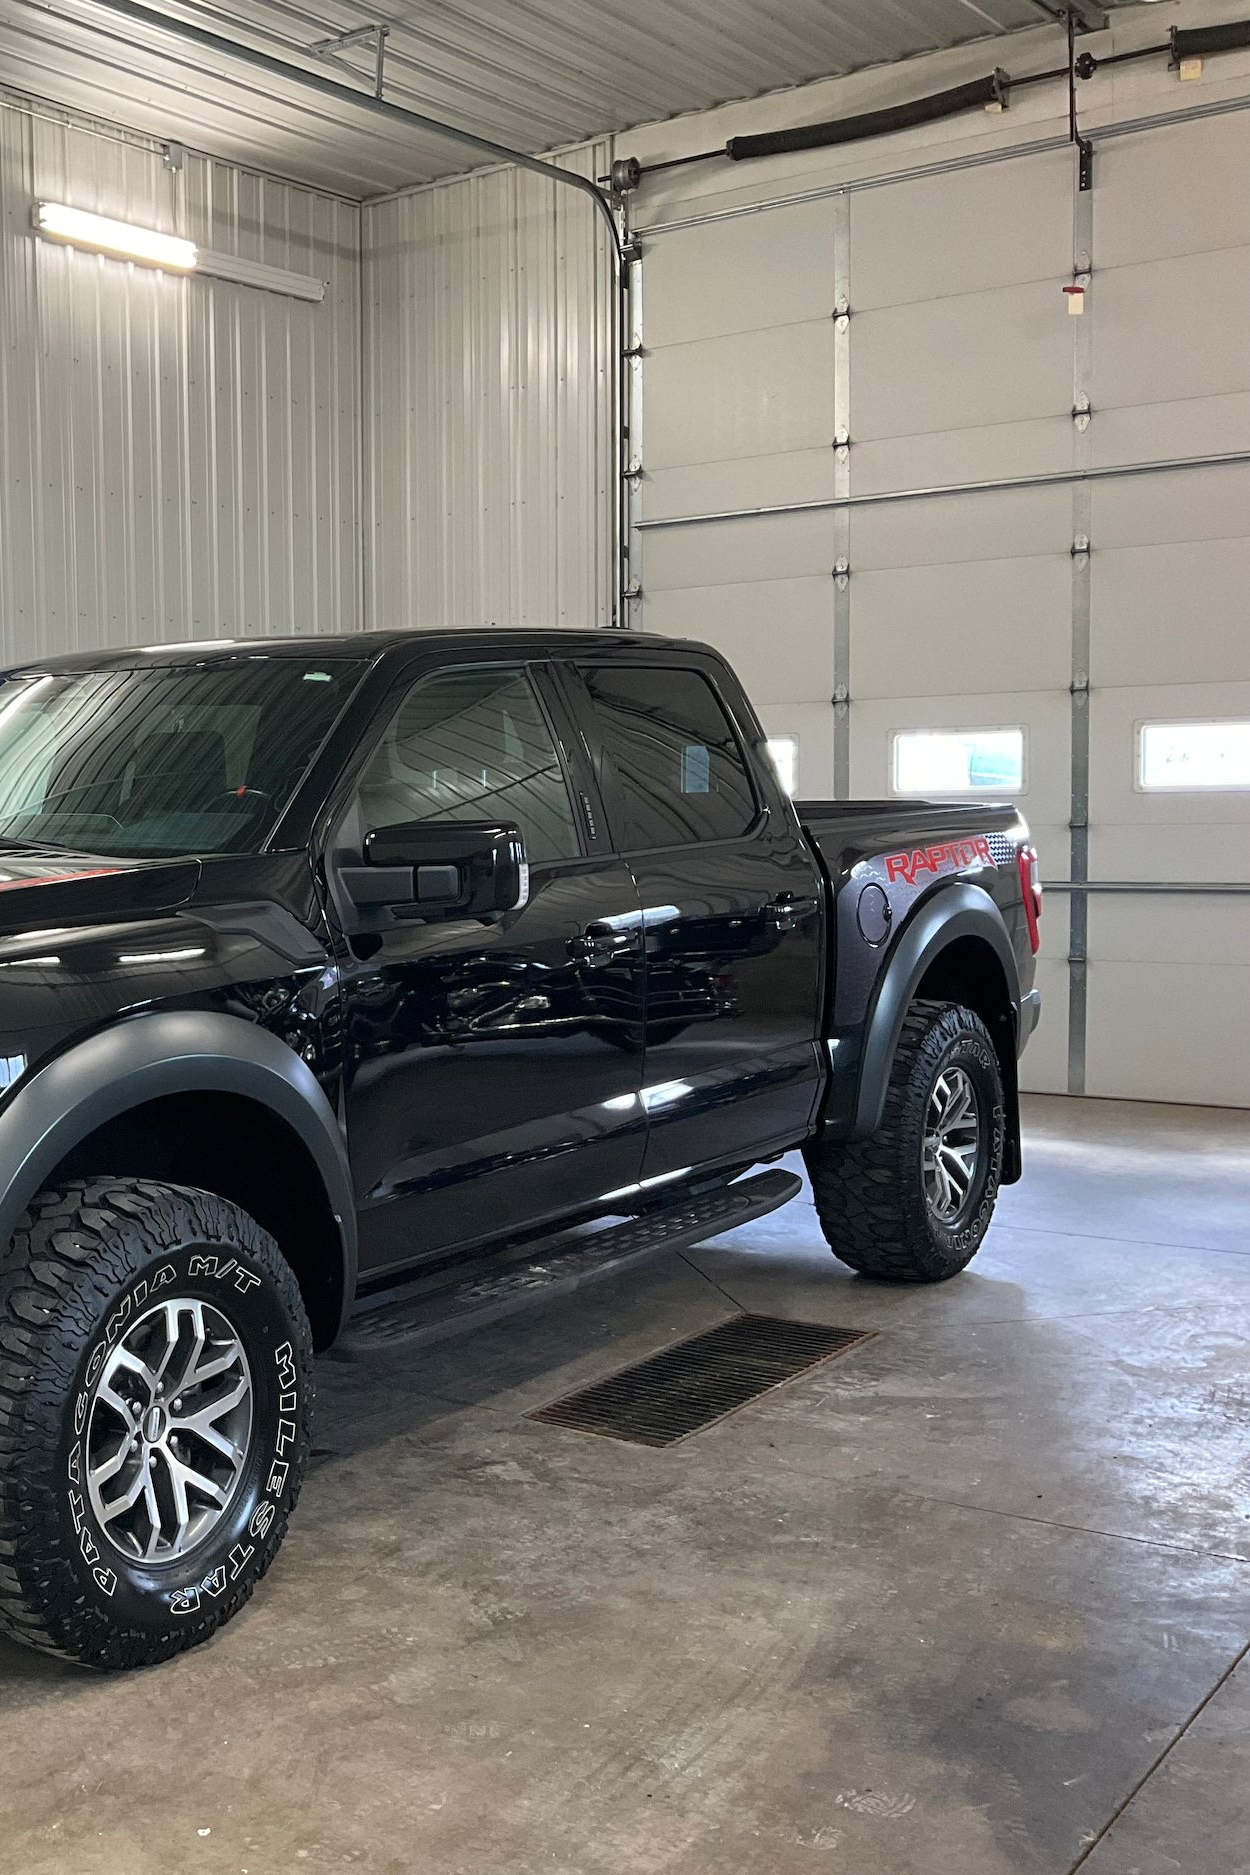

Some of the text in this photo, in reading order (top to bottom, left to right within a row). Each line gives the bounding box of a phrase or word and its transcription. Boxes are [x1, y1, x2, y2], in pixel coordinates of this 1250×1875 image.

[884, 838, 999, 887] RAPTOR
[67, 1255, 261, 1597] PATAGONIA M/T
[170, 1340, 296, 1615] MILESTAR
